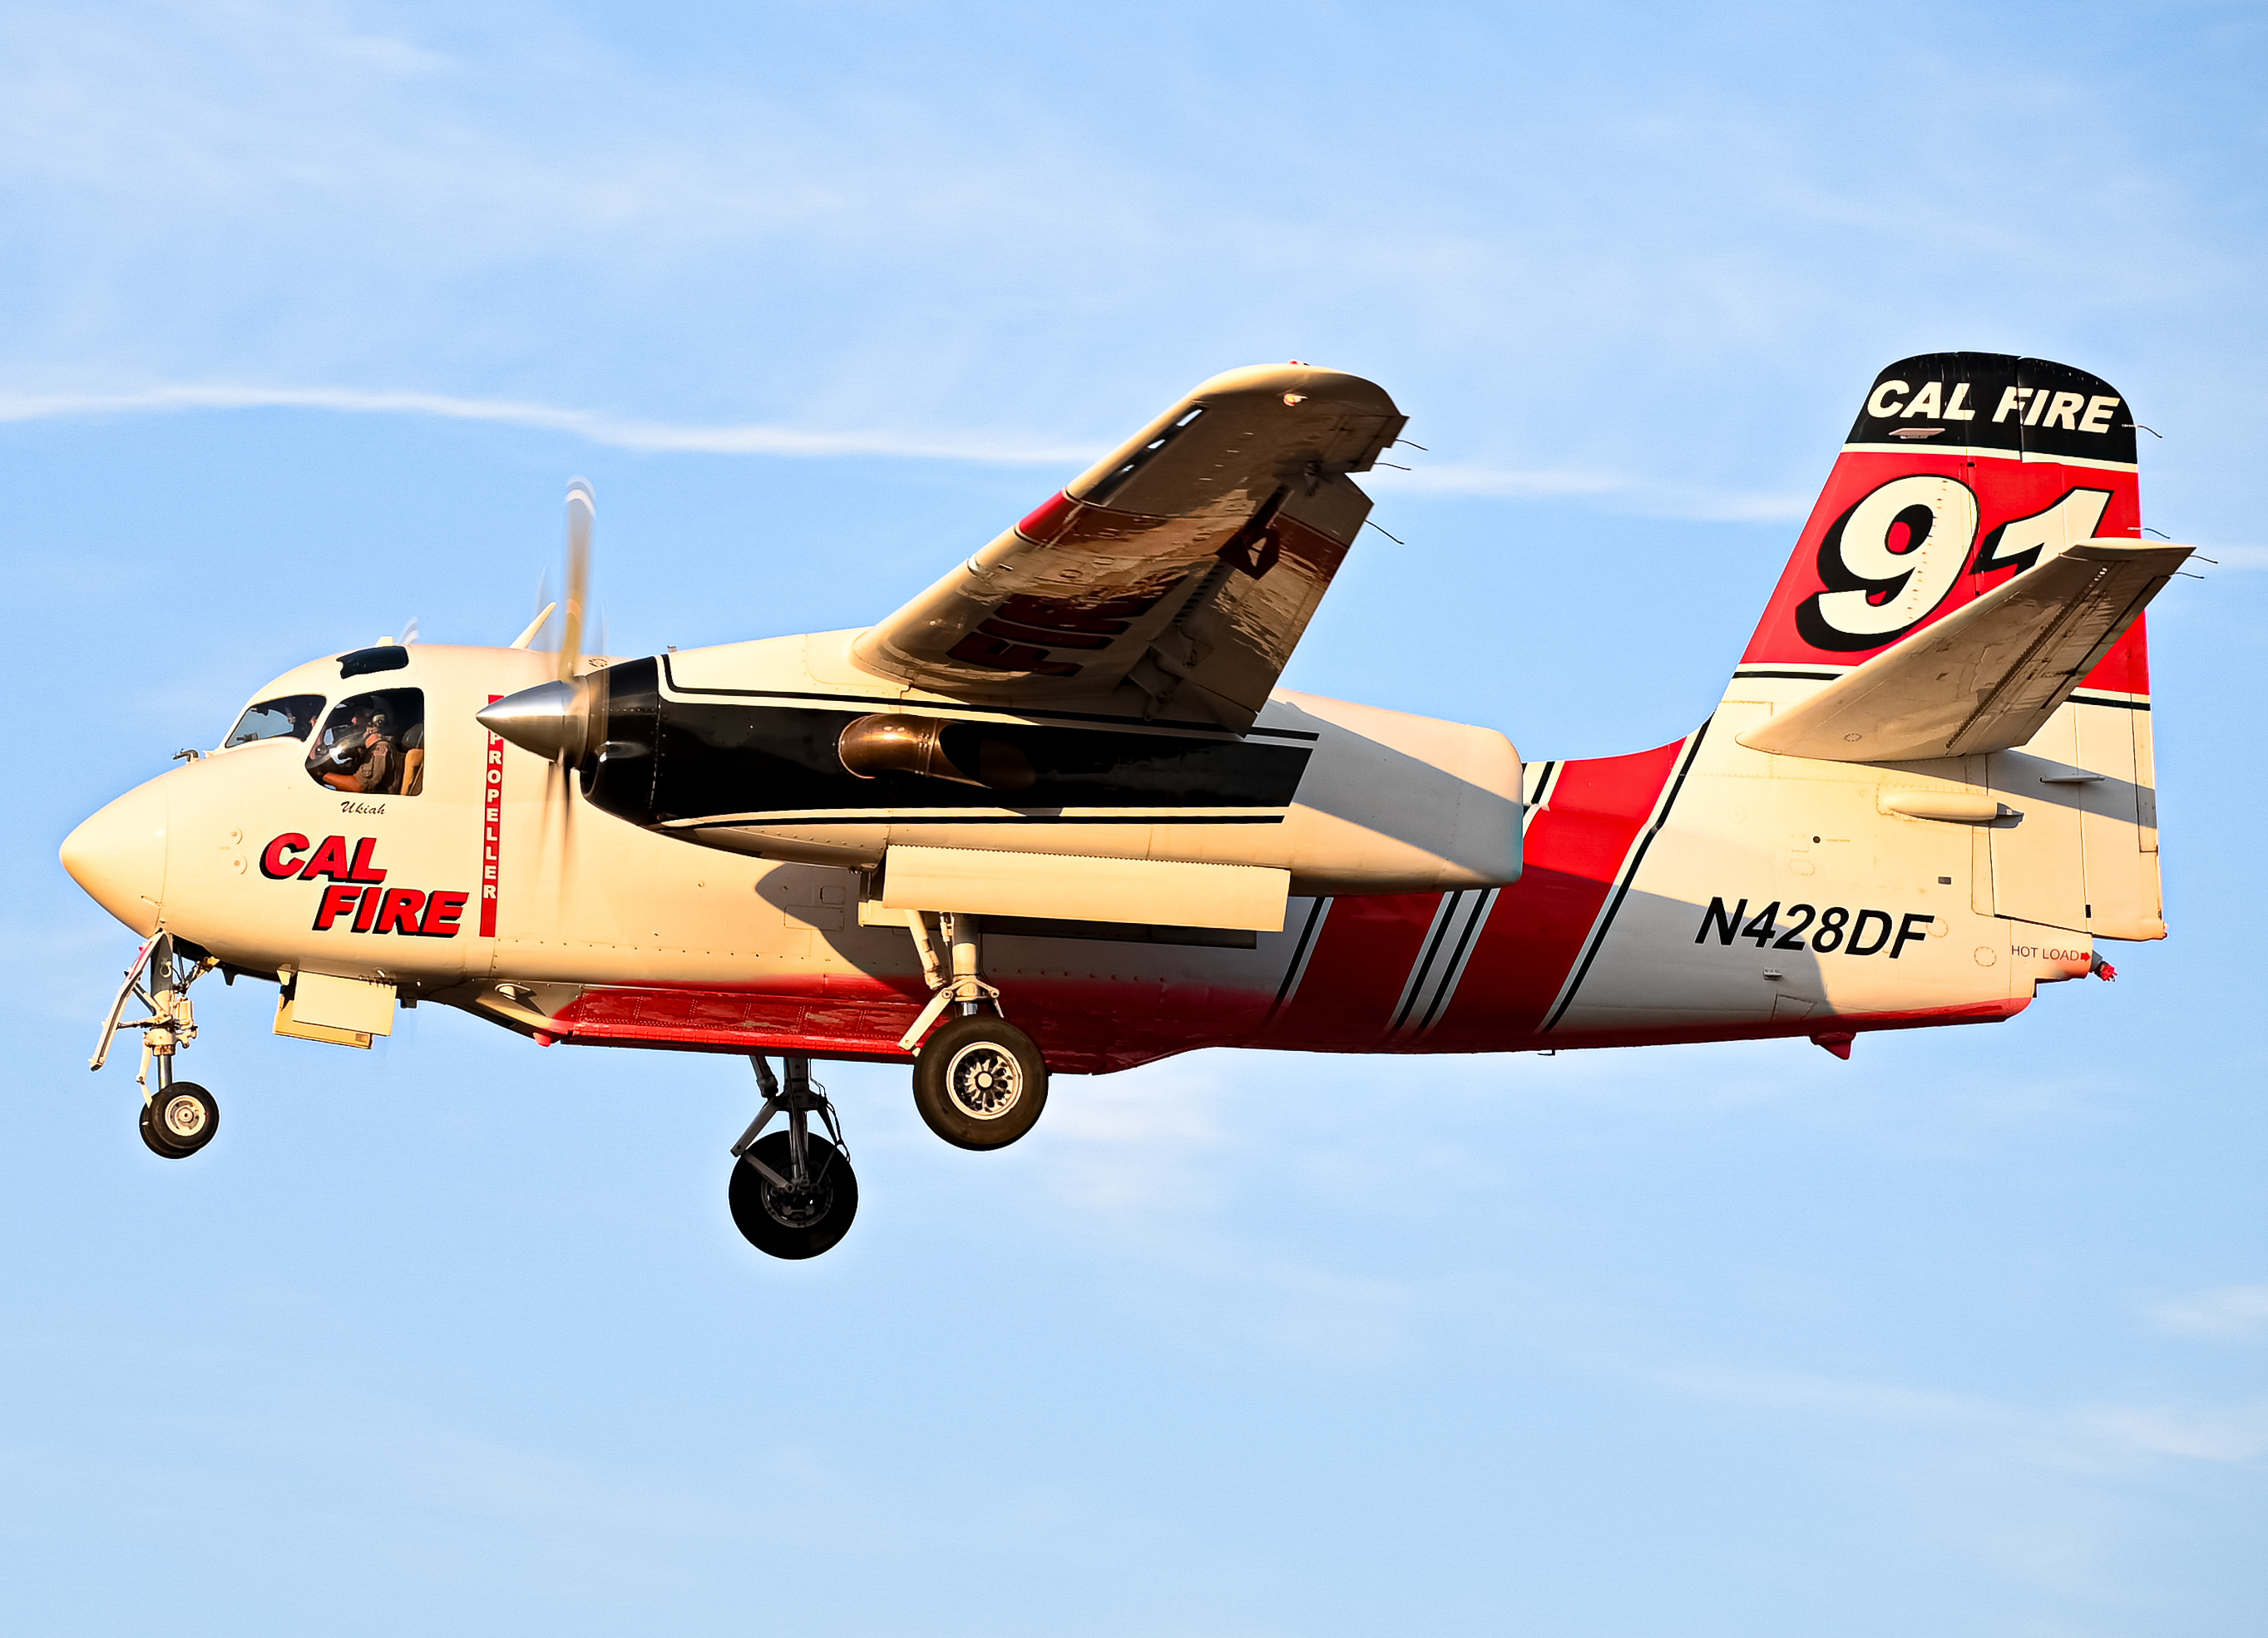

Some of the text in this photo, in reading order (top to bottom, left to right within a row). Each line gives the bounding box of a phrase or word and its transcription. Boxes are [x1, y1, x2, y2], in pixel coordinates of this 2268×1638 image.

[1867, 380, 2121, 434] CAL FIRE
[1795, 472, 2114, 653] 91
[340, 800, 386, 815] Ukiah
[482, 728, 503, 900] PROPELLER
[259, 832, 388, 886] CAL
[311, 885, 470, 939] FIRE
[1694, 895, 1935, 960] N428DF
[2011, 945, 2079, 961] HOT LOAD
